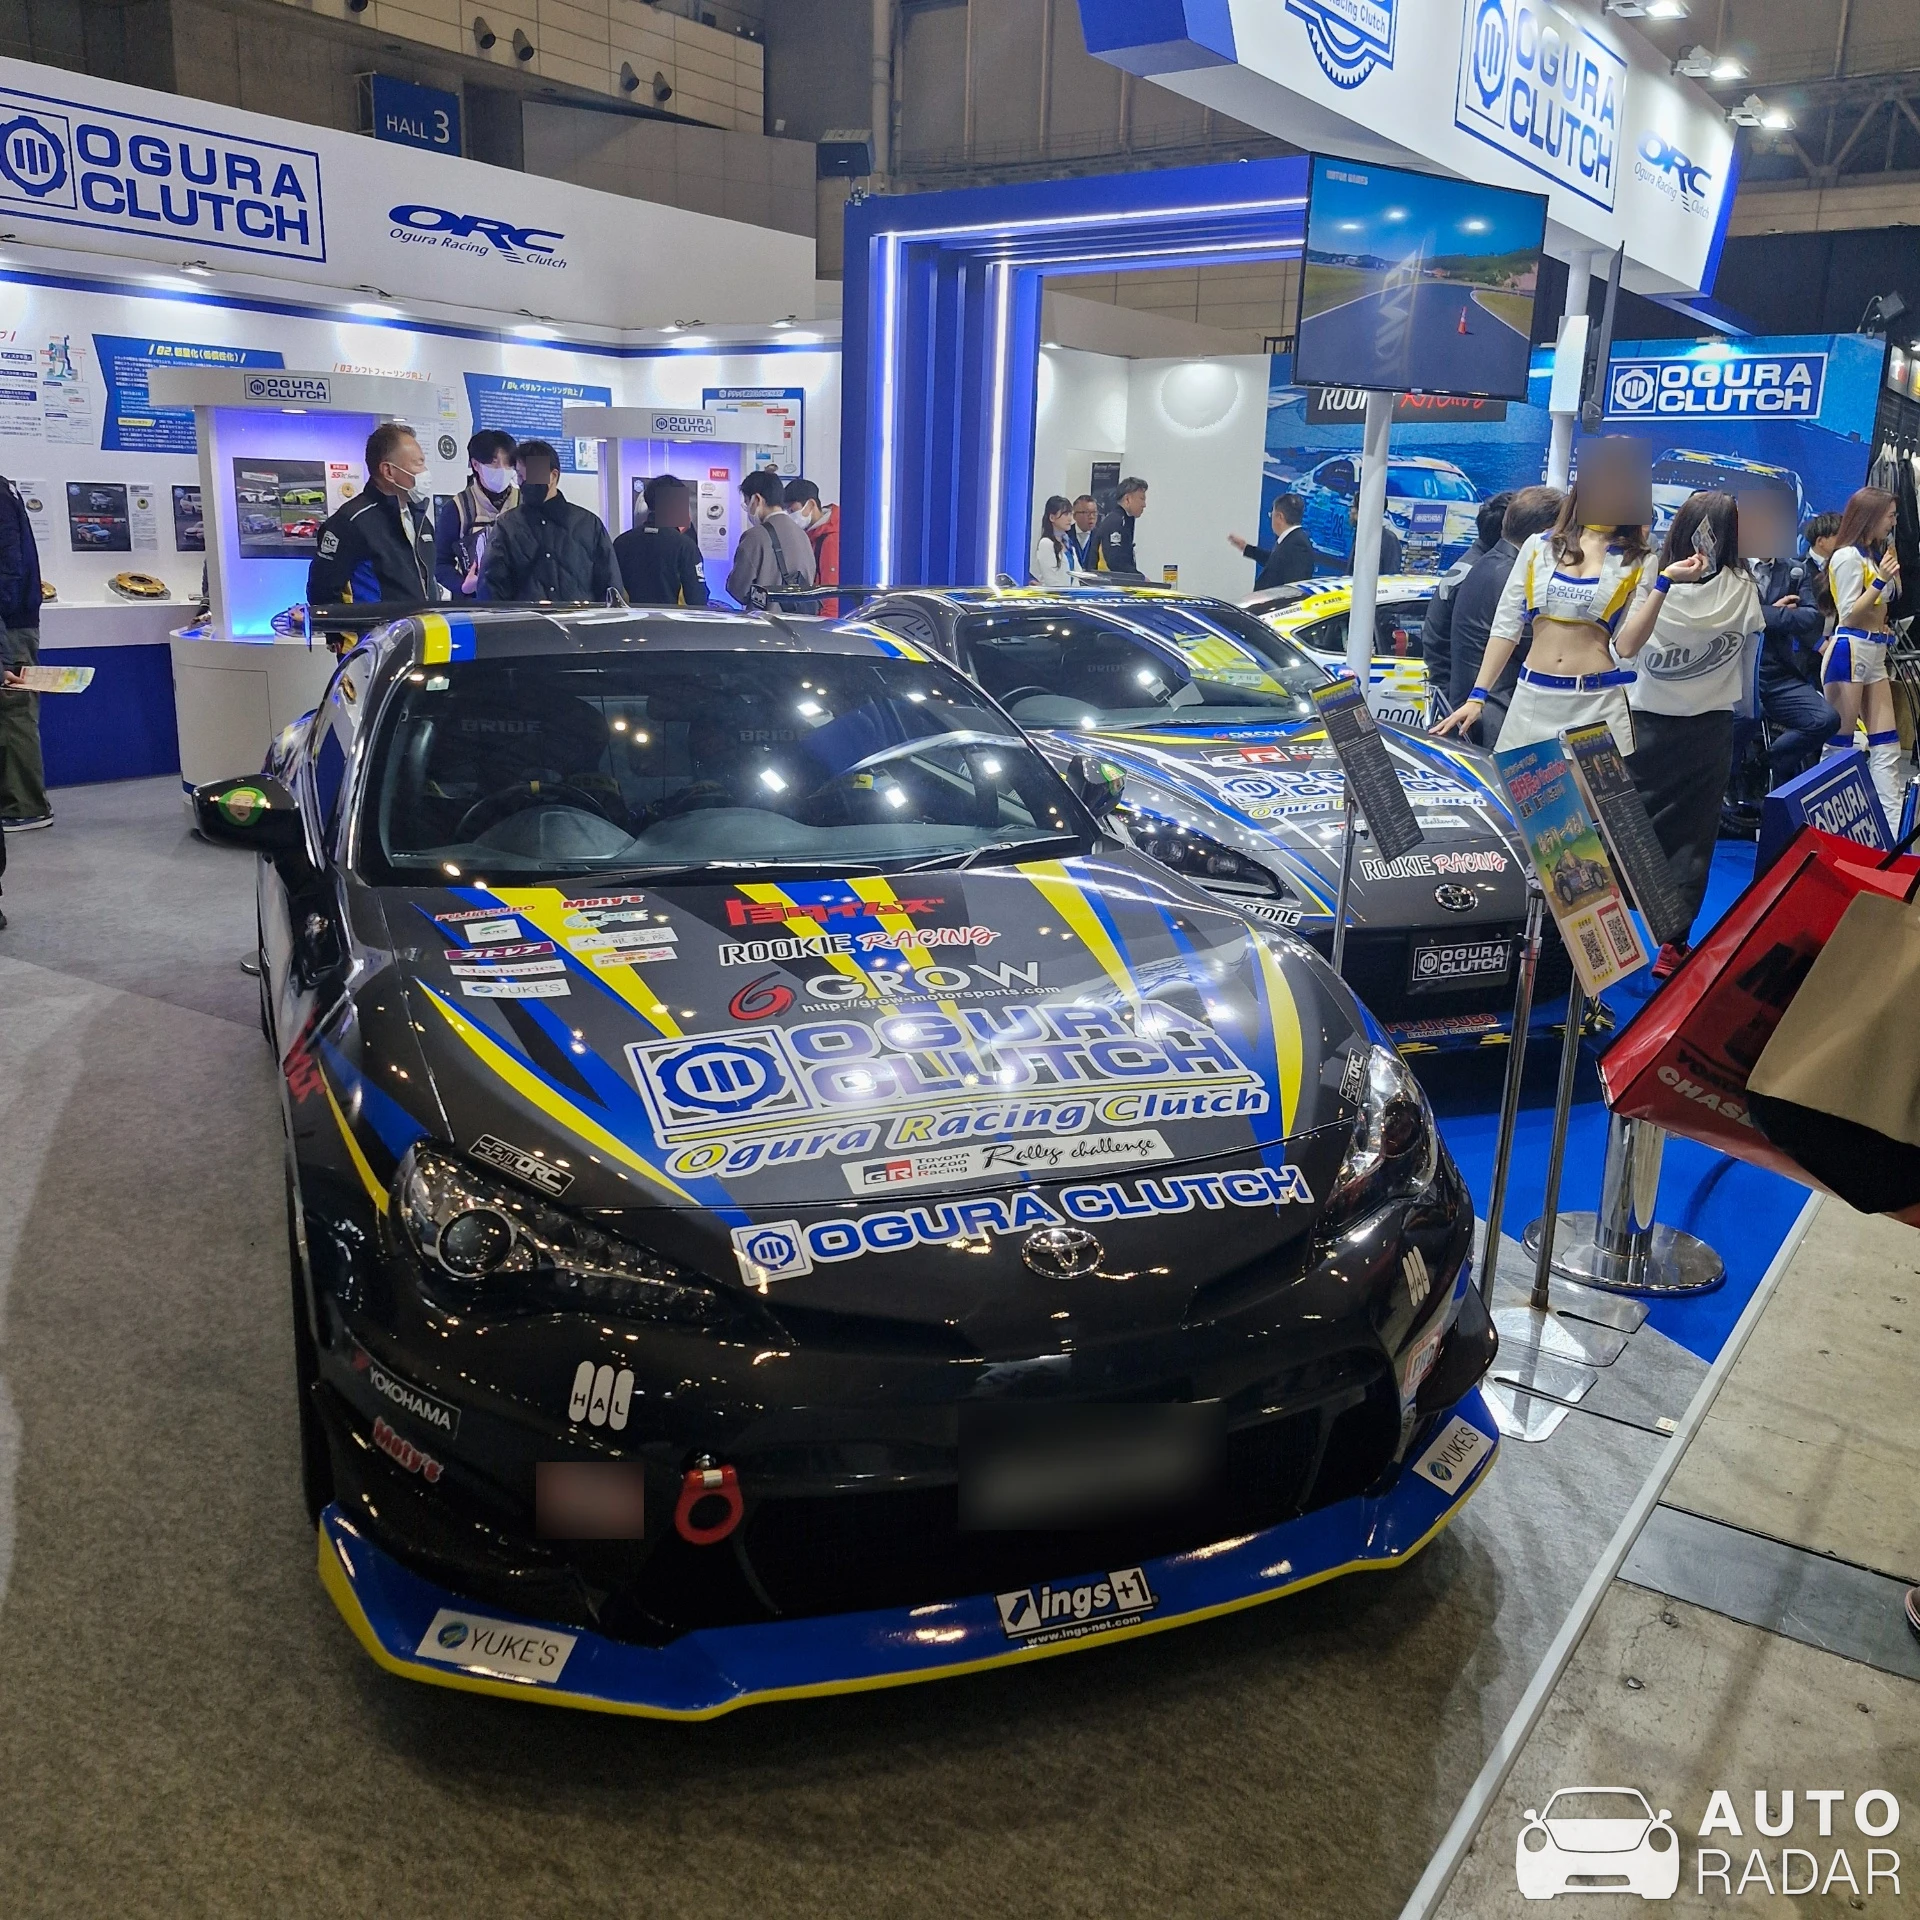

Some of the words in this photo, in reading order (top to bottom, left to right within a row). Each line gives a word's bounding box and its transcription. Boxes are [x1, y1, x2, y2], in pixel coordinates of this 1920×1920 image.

[1328, 0, 1359, 22] acing
[1360, 6, 1386, 34] Clutch
[1514, 7, 1615, 130] OGURA
[386, 113, 428, 140] HALL
[433, 110, 451, 144] 3
[1509, 77, 1612, 188] CLUTCH
[77, 124, 306, 203] OGURA
[1637, 130, 1712, 198] ORC
[1634, 161, 1655, 184] Ogura
[1656, 176, 1677, 202] Racing
[1691, 199, 1710, 220] Clutch
[80, 172, 309, 246] CLUTCH
[388, 204, 565, 254] ORC
[389, 228, 437, 247] Ogura
[441, 236, 489, 257] Racing
[526, 251, 568, 269] Clutch
[267, 378, 326, 392] OGURA
[1661, 363, 1812, 388] OGURA
[267, 387, 328, 402] CLUTCH
[1658, 388, 1811, 411] CLUTCH
[669, 416, 712, 426] OGURA
[669, 425, 713, 434] CLUTCH
[711, 470, 727, 478] NEW
[1081, 597, 1143, 605] CLUTCH
[1558, 585, 1595, 596] OGUR
[461, 719, 544, 734] BRIDE
[1212, 753, 1286, 767] GR
[1273, 768, 1451, 783] OGRA
[1252, 802, 1326, 818] Ogura
[1419, 797, 1484, 807] Clutch
[1824, 781, 1869, 834] OGURA
[1362, 856, 1434, 881] ROOKIE
[1433, 851, 1507, 874] RACING
[436, 905, 536, 921] FUJITSUBO
[562, 895, 644, 909] Moty's
[726, 897, 945, 926] トヨタイムズ
[721, 934, 853, 964] ROOKIE
[858, 927, 998, 950] RACING
[1441, 945, 1505, 962] OGURA
[460, 963, 556, 974] Mawberries
[1439, 957, 1504, 974] CLUTCH
[496, 983, 561, 995] YUKE'S
[805, 961, 1039, 1001] GROW
[802, 984, 1061, 1013] http://grow-motorsports.com
[796, 1003, 1213, 1061] OGURA
[1385, 1013, 1498, 1034] FUJITSUBO
[1407, 1028, 1448, 1039] EXHAUST
[1449, 1025, 1489, 1035] SYSTEMS
[812, 1034, 1245, 1104] CLUTCH
[676, 1128, 874, 1174] Ogura
[901, 1104, 1091, 1143] Racing
[1102, 1089, 1265, 1122] Clutch
[916, 1152, 970, 1164] TOYOTA
[1071, 1136, 1155, 1160] challenge
[864, 1161, 911, 1185] GR
[917, 1160, 967, 1172] GAZOO
[917, 1167, 969, 1178] Racing
[808, 1195, 1055, 1262] OGURA
[1066, 1167, 1308, 1220] CLUTCH
[369, 1366, 452, 1431] YOKOHAMA
[573, 1391, 624, 1417] HAL
[372, 1416, 444, 1483] Moty's
[1438, 1425, 1480, 1469] YUKE'S
[1041, 1581, 1111, 1619] ings
[1026, 1614, 1142, 1646] www.ings-net.com
[470, 1628, 559, 1668] YUKE'S
